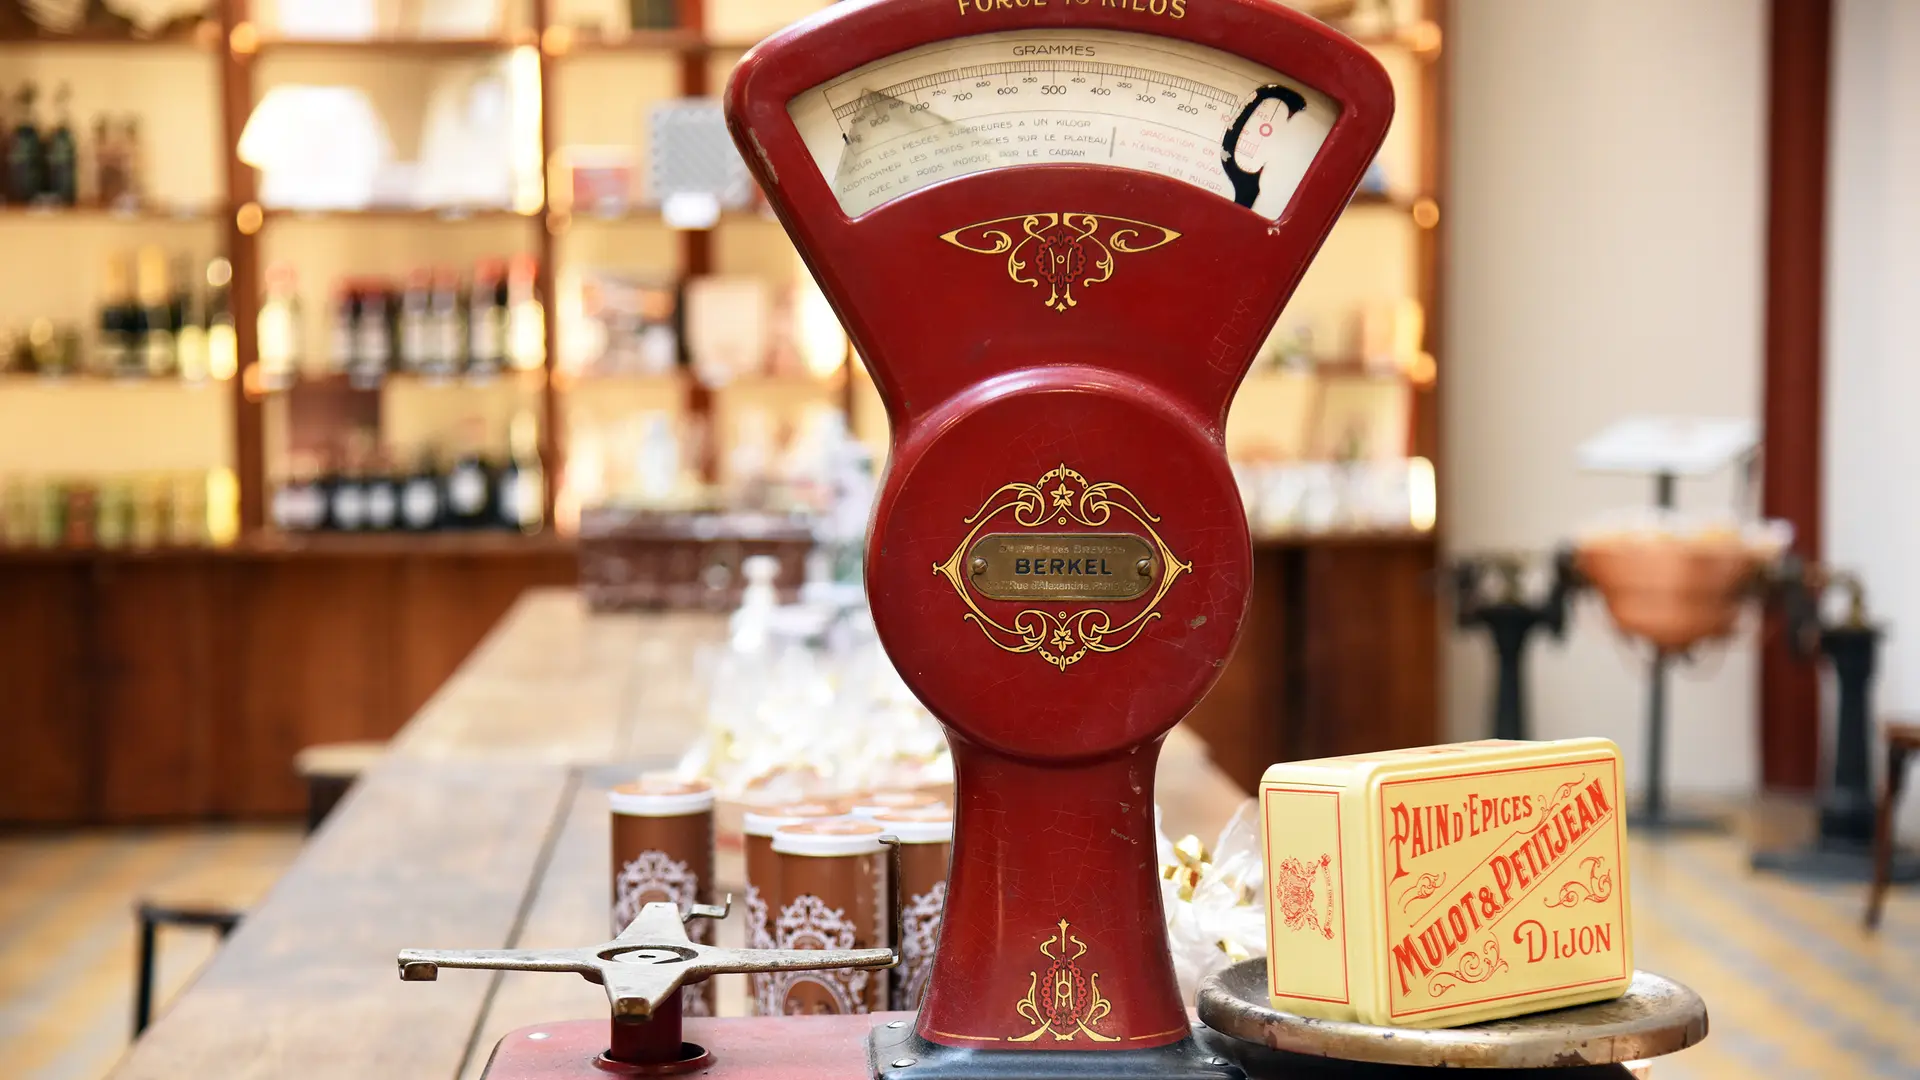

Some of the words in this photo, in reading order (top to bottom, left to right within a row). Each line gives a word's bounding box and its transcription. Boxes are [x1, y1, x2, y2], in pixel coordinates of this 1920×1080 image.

[958, 0, 1047, 15] FOR
[1013, 45, 1096, 57] GRAMMES
[910, 102, 930, 114] 800
[932, 88, 947, 97] 750
[953, 92, 973, 102] 700
[976, 80, 991, 88] 650
[997, 86, 1018, 95] 600
[1022, 76, 1038, 84] 550
[1041, 85, 1067, 95] 500
[1090, 87, 1111, 96] 400
[1136, 94, 1156, 104] 300
[1162, 90, 1177, 99] 250
[1177, 103, 1198, 115] 200
[1204, 102, 1217, 111] 150
[1033, 119, 1048, 127] UN
[935, 142, 964, 157] POIDS
[1017, 134, 1038, 143] SUR
[1045, 133, 1056, 142] LE
[1064, 134, 1107, 146] PLATEAU
[868, 182, 893, 198] AVEC
[916, 163, 945, 177] POIDS
[1027, 148, 1039, 158] LE
[1049, 149, 1086, 158] CADRAN
[1015, 558, 1113, 576] BERKEL
[1389, 802, 1450, 887] PAIN
[1513, 919, 1612, 964] DIJON
